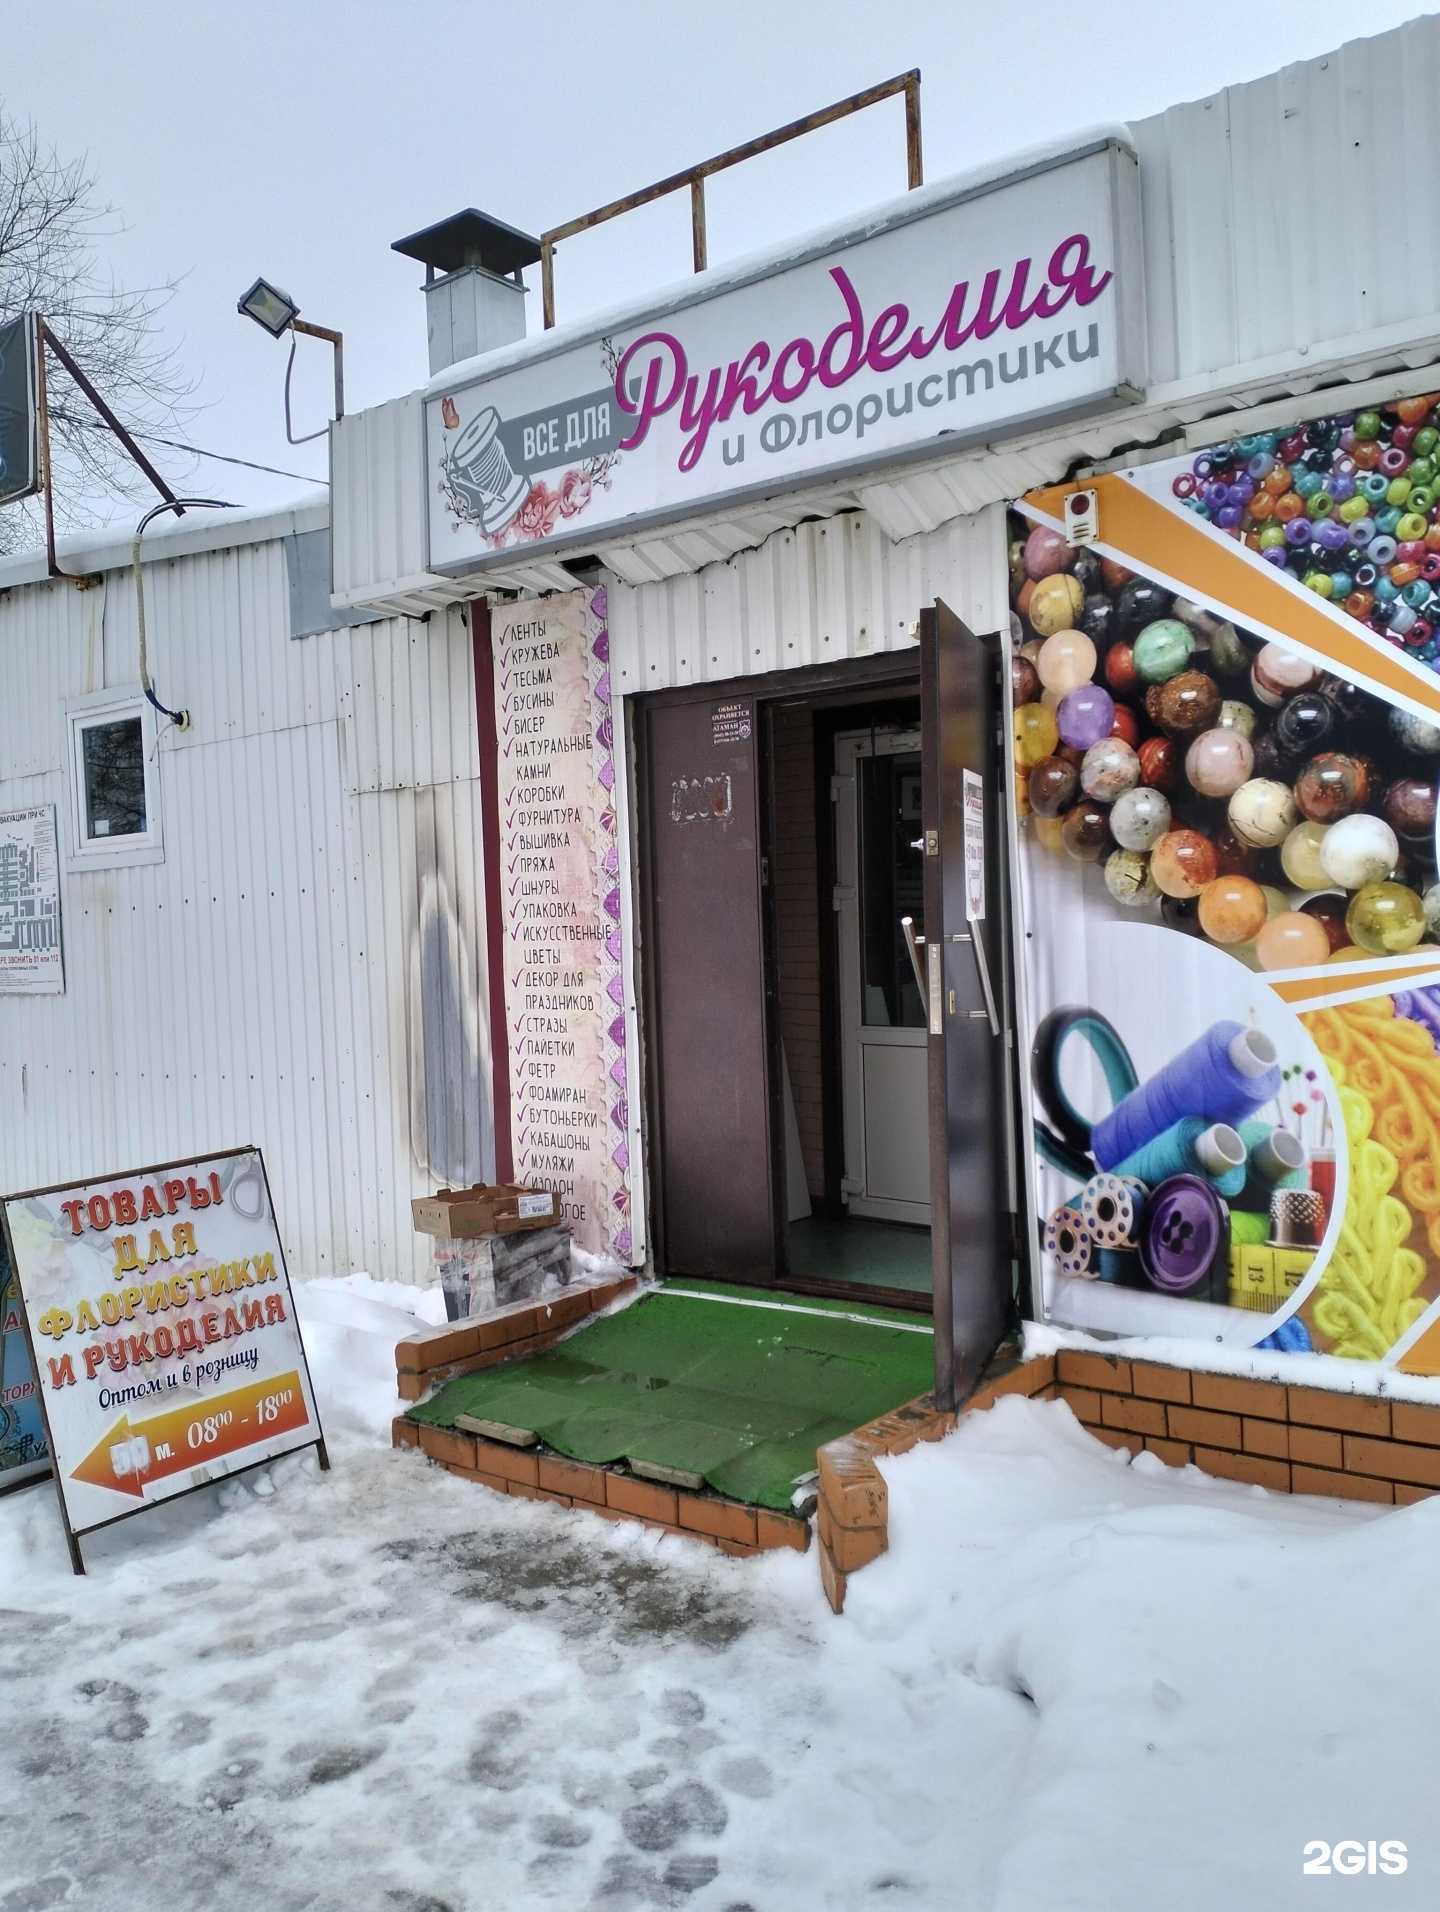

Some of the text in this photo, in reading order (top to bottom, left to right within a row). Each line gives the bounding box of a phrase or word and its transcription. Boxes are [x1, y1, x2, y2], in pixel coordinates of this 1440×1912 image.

[615, 232, 1114, 474] Рукоделия
[721, 322, 1100, 466] и Флористики
[523, 401, 611, 461] ВСЕ ДЛЯ
[511, 621, 546, 641] ЛЕНТЫ
[512, 642, 560, 664] КРУЖЕВА
[513, 669, 553, 688] ТЕСЬМА
[513, 691, 554, 712] БУСИНЫ
[514, 716, 545, 735] БИСЕР
[516, 734, 593, 758] НАТУРАЛЬНЫЕ
[516, 763, 551, 781] КАМНИ
[518, 785, 565, 804] КОРОБКИ
[518, 808, 581, 827] ФУРНИТУРА
[520, 832, 571, 850] ВЫШИВКА
[520, 856, 556, 873] ПРЯЖА
[521, 879, 560, 896] ШНУРЫ
[522, 902, 577, 919] УПАКОВКА
[523, 924, 612, 942] ИСКУССТВЕННЫЕ
[524, 949, 561, 965] ЦВЕТЫ
[525, 971, 584, 987] ДЕКОР ДЛЯ
[525, 995, 594, 1011] ПРАЗДНИКОВ
[526, 1017, 568, 1033] СТРАЗЫ
[527, 1038, 575, 1056] ПАЙЕТКИ
[528, 1062, 556, 1079] ФЕТР
[529, 1086, 586, 1103] ФОАМИРАН
[530, 1108, 598, 1128] БУТОНЬЕРКИ
[530, 1131, 590, 1150] КАБАШОНЫ
[531, 1154, 575, 1172] МУЛЯЖИ
[61, 1171, 225, 1235] ТОВАРЫ
[111, 1221, 200, 1280] ДЛЯ
[38, 1251, 279, 1340] ФЛОРИСТИКИ
[46, 1293, 288, 1389] И РУКОДЕЛИЯ
[99, 1347, 259, 1409] Оптом и в розницу
